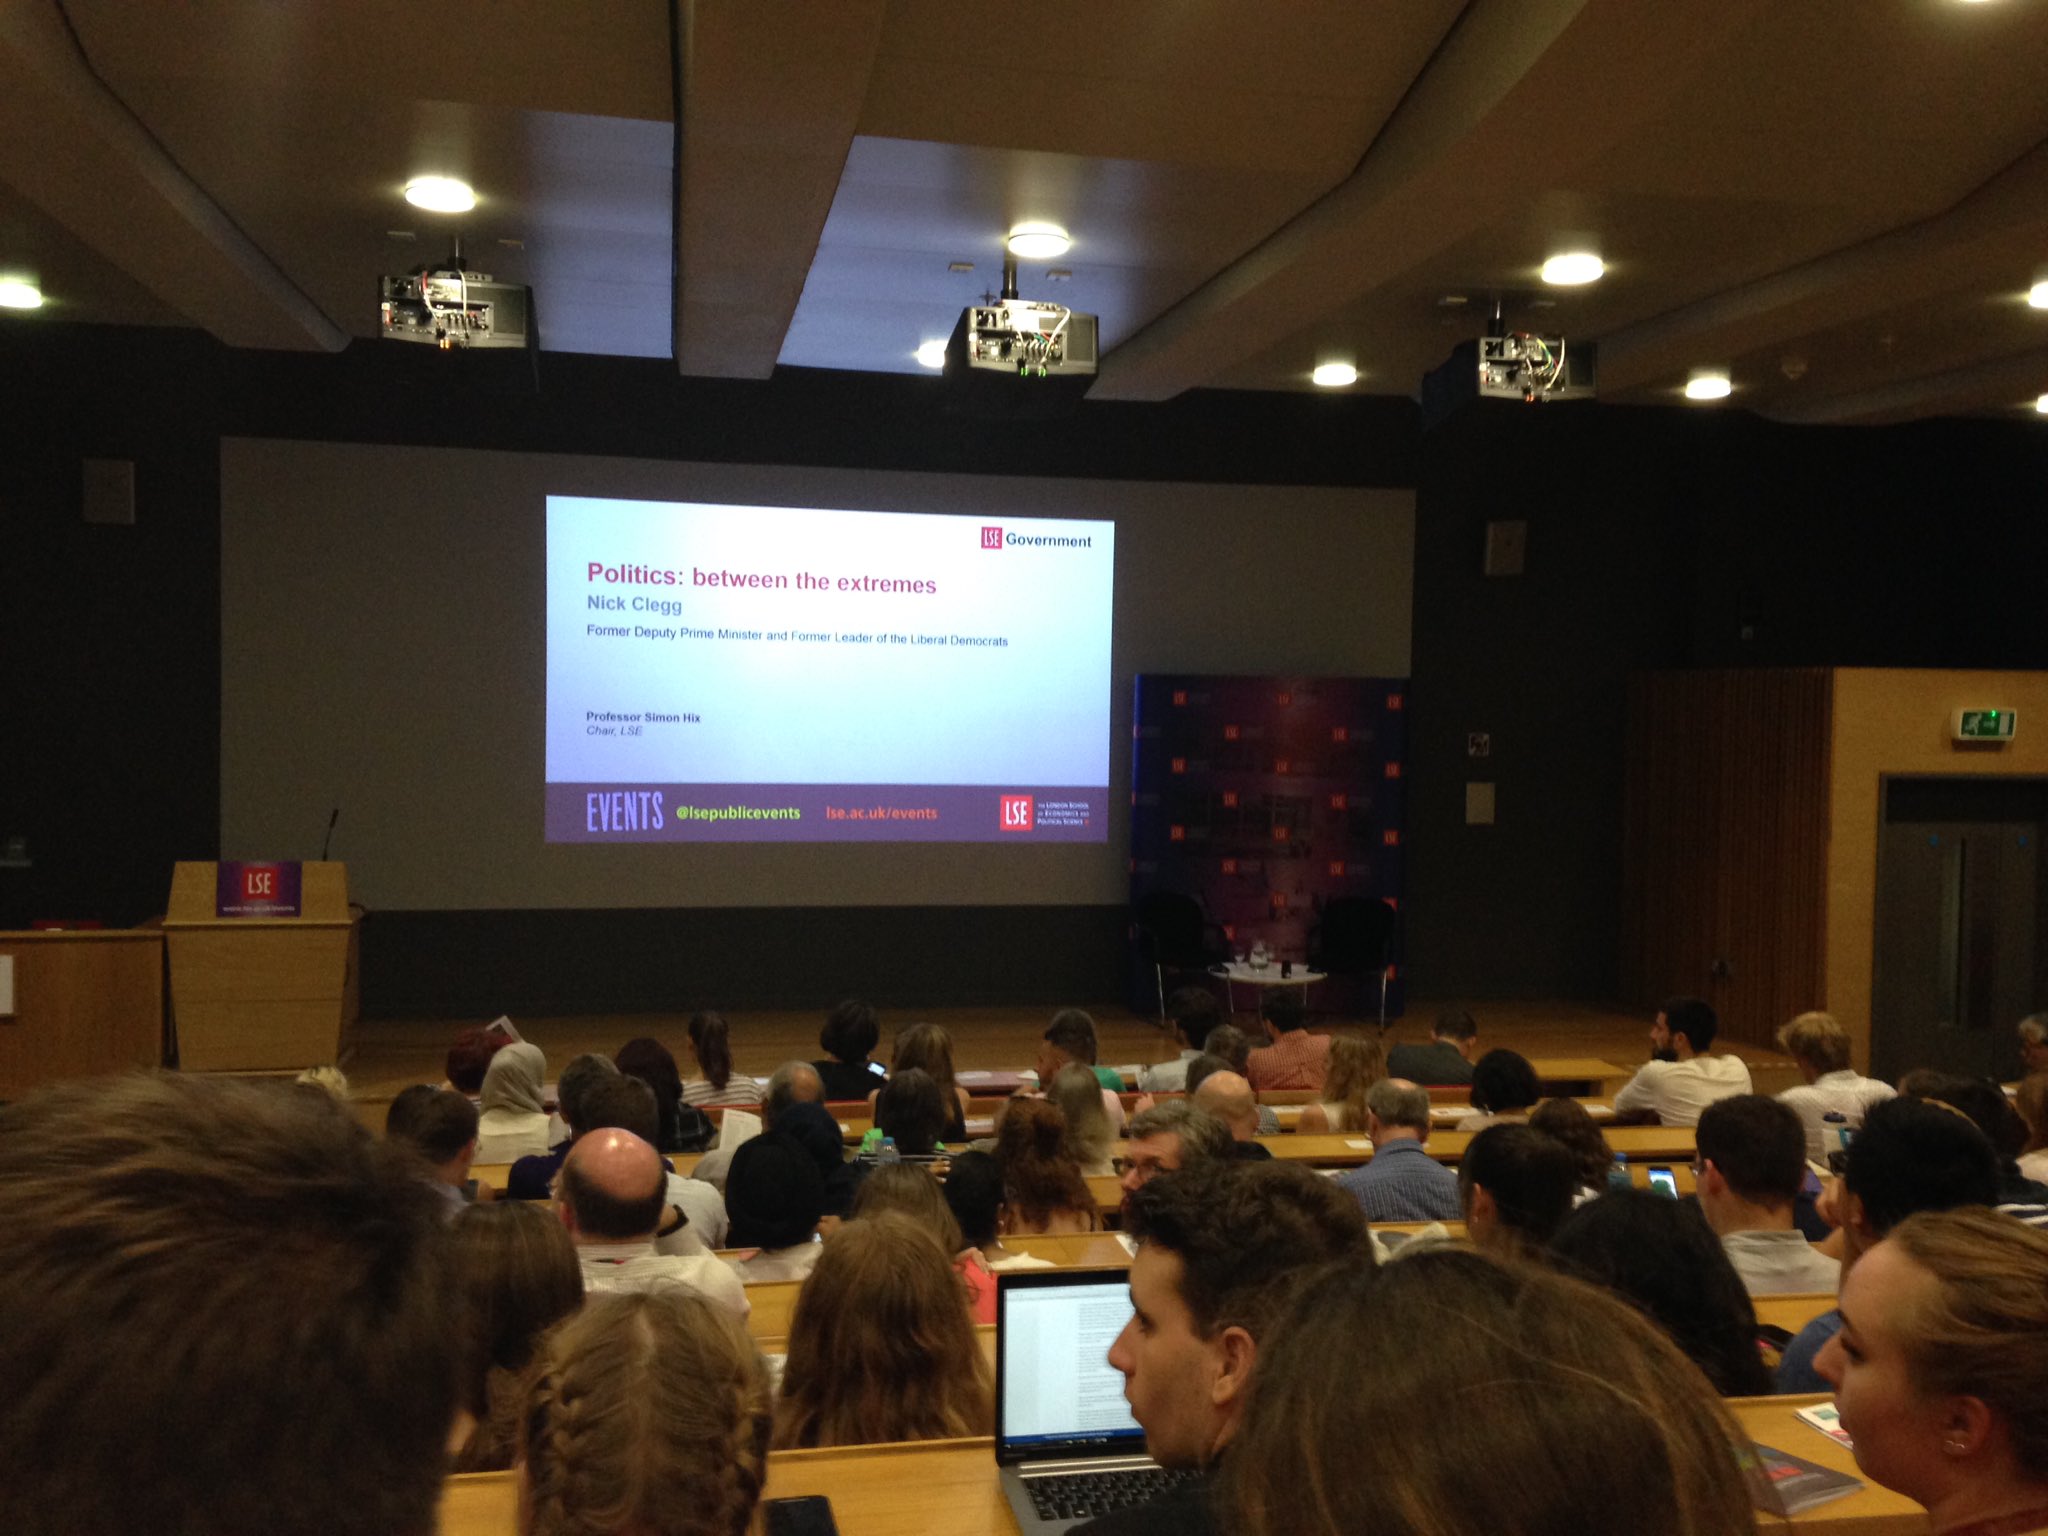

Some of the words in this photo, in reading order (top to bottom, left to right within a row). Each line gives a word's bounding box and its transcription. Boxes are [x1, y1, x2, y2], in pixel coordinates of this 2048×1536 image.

[983, 528, 1000, 547] LSE
[1006, 532, 1092, 548] Government
[587, 562, 683, 586] Politics:
[692, 567, 788, 589] between
[796, 571, 830, 591] the
[837, 574, 937, 595] extremes
[587, 595, 626, 611] Nick
[632, 596, 683, 617] Clegg
[587, 624, 630, 638] Former
[634, 626, 676, 641] Deputy
[680, 627, 714, 640] Prime
[718, 628, 762, 641] Minister
[766, 630, 788, 642] and
[792, 630, 831, 643] Former
[835, 631, 873, 644] Leader
[876, 633, 888, 645] of
[890, 633, 908, 645] the
[910, 634, 947, 646] Liberal
[950, 635, 1009, 647] Democrats
[586, 711, 641, 723] Professor
[644, 712, 680, 723] Simon
[683, 713, 701, 724] Hix
[586, 725, 617, 737] Chair,
[620, 725, 643, 737] LSE
[587, 791, 664, 832] EVENTS
[676, 805, 801, 822] @lsepublicevents
[826, 805, 938, 820] lse.ac.uk/events
[1004, 800, 1028, 826] LSE
[247, 872, 272, 895] LSE
